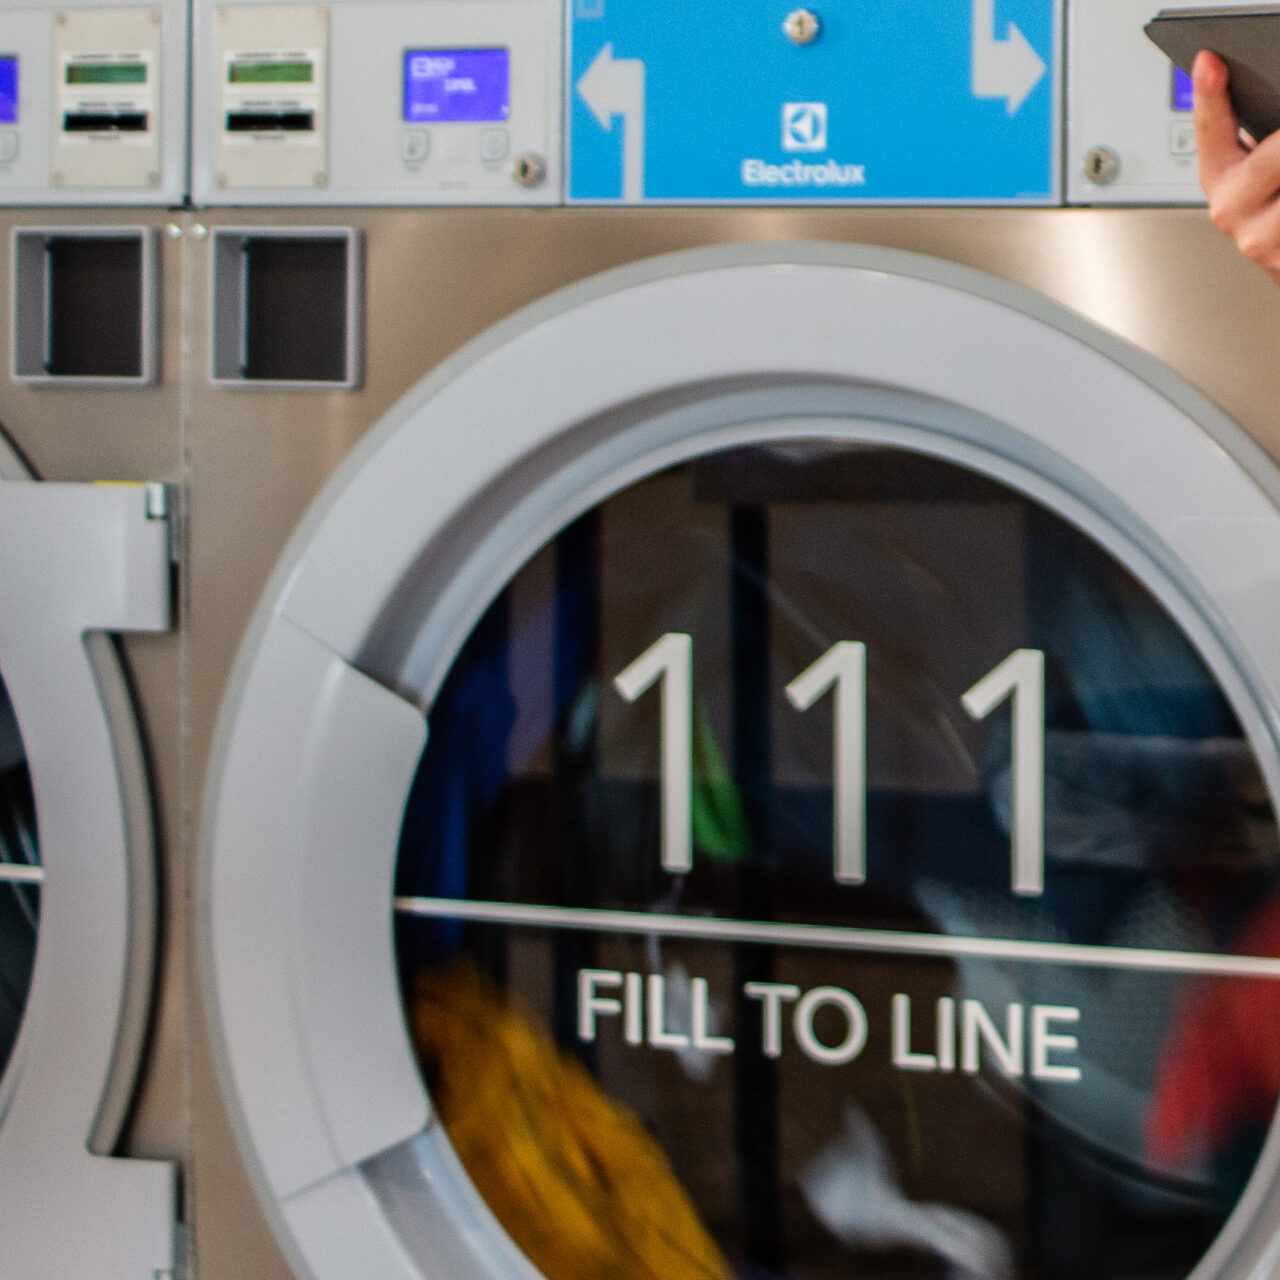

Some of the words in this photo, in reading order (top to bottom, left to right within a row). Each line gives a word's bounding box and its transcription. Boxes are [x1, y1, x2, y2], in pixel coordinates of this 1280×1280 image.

[741, 157, 867, 186] Electrolux
[613, 632, 1046, 896] 111
[577, 968, 736, 1053] FILL
[744, 981, 869, 1065] TO
[891, 992, 1083, 1081] LINE
